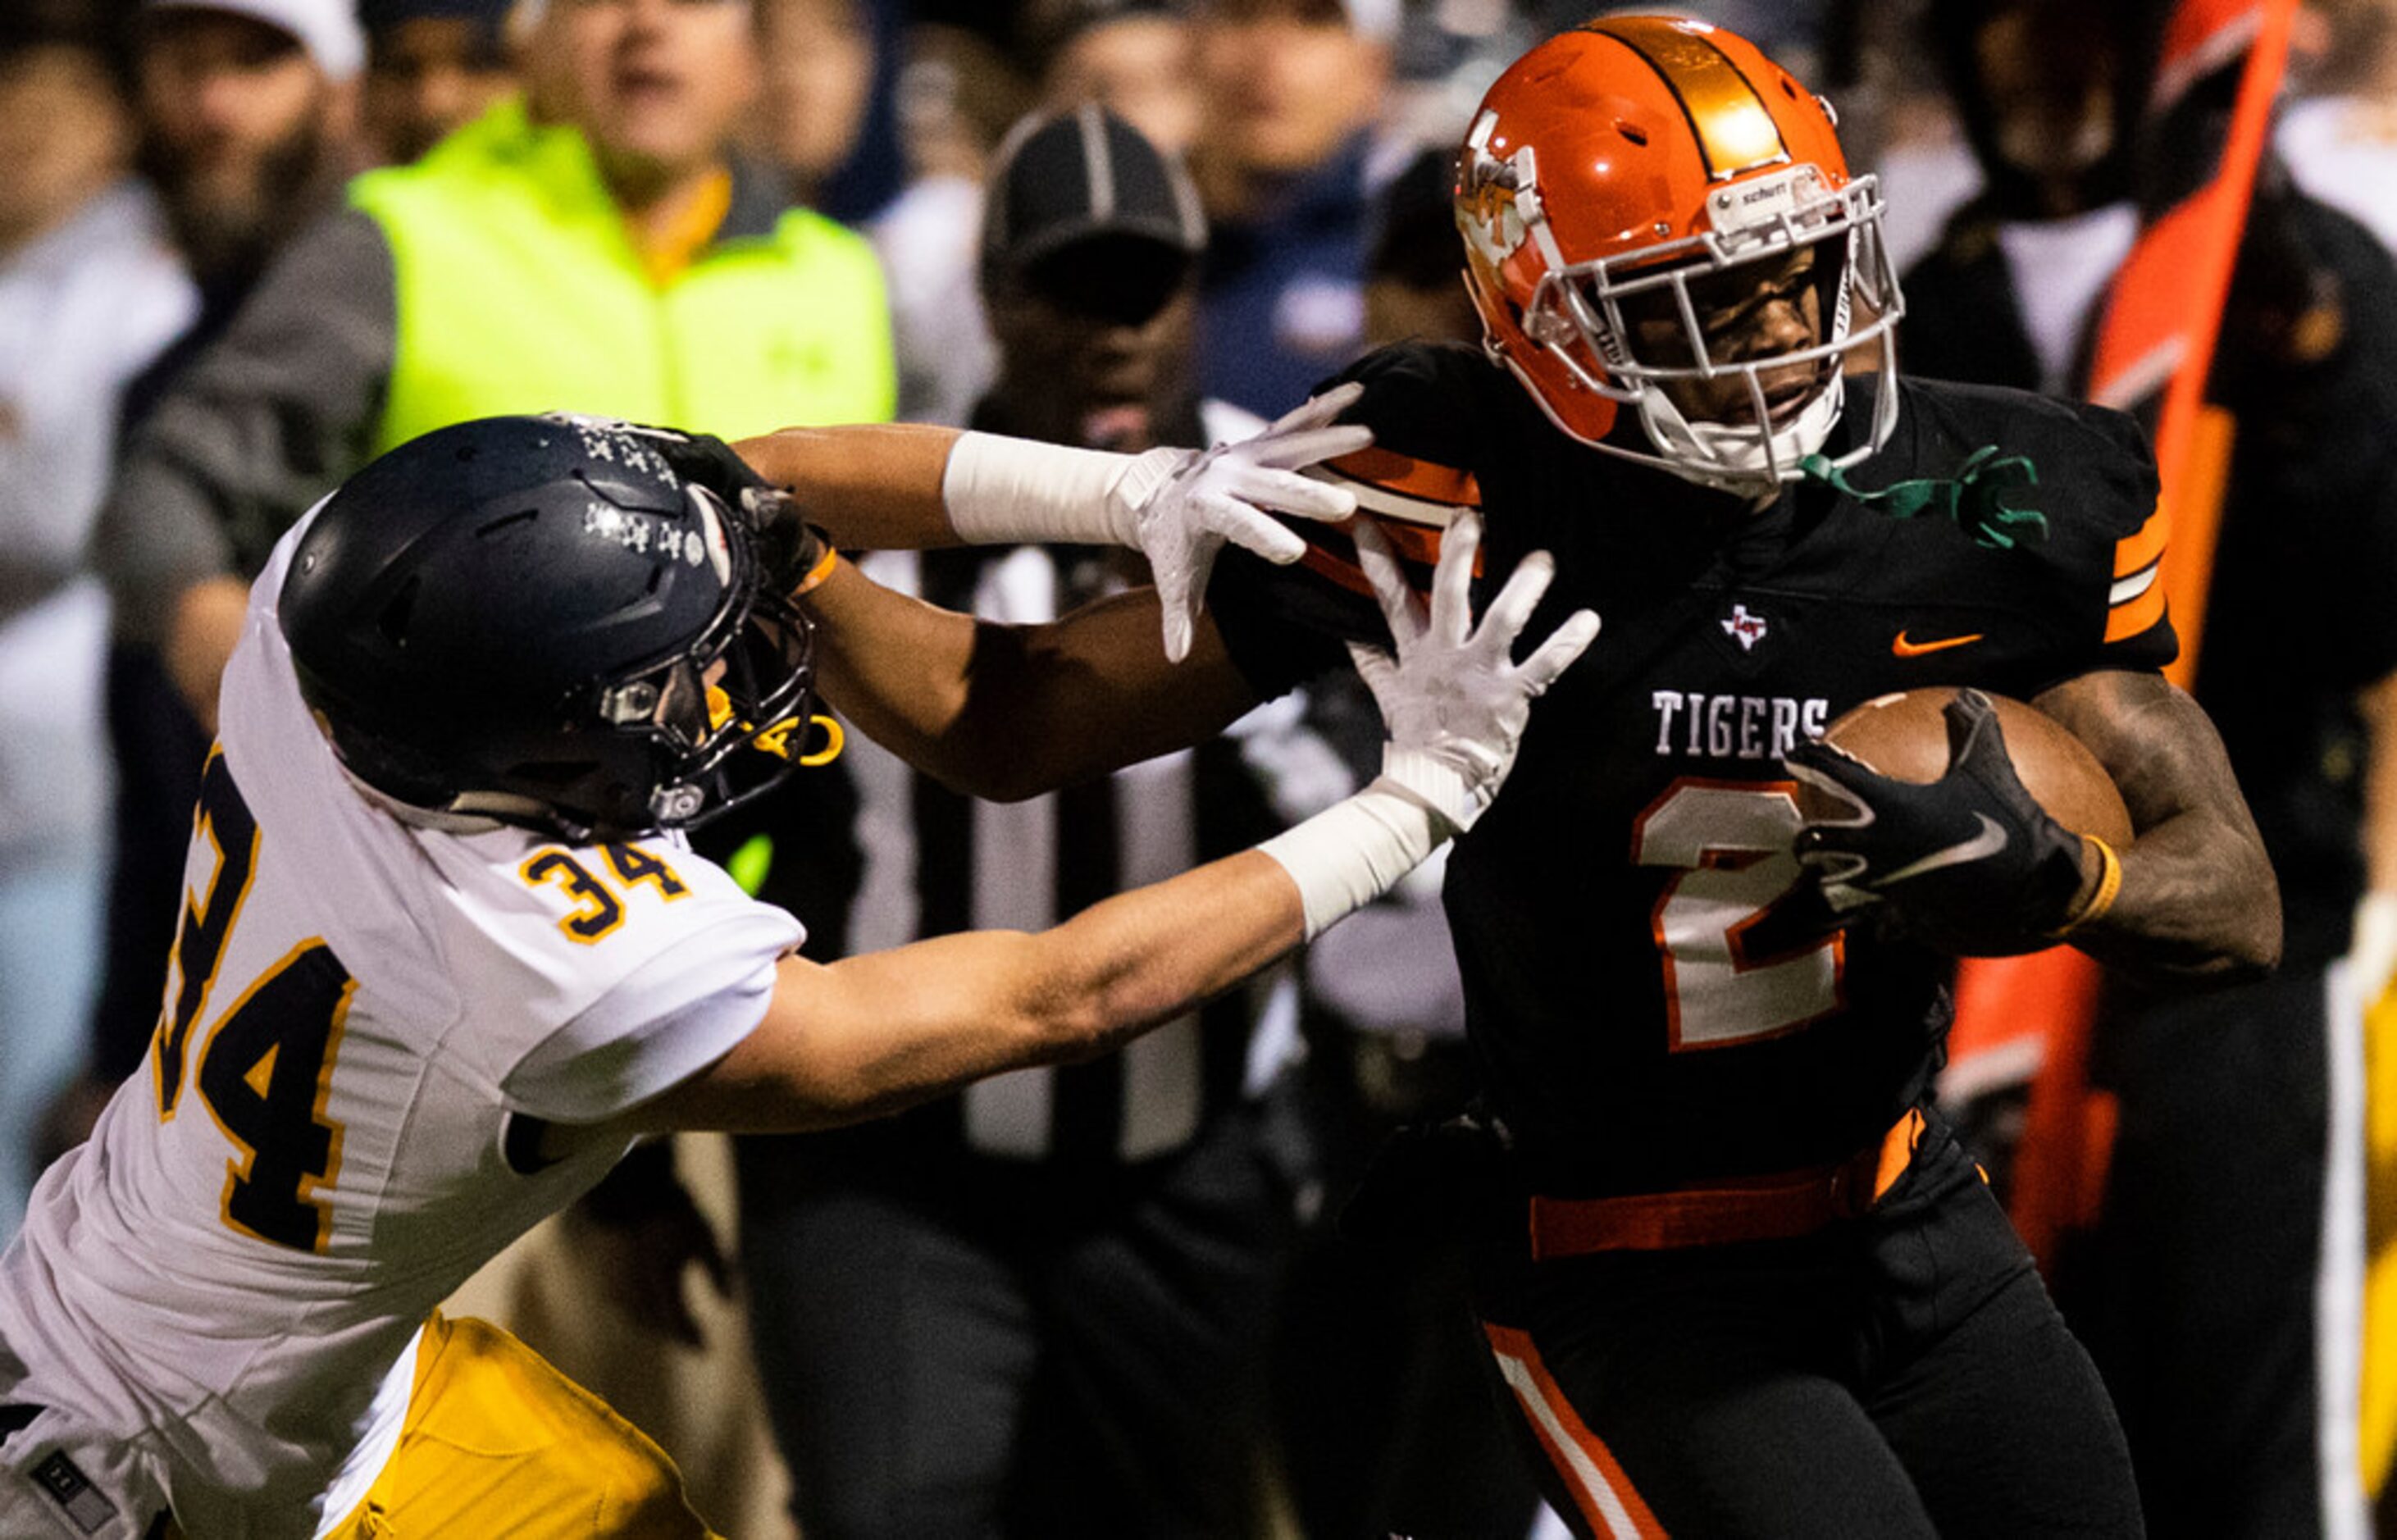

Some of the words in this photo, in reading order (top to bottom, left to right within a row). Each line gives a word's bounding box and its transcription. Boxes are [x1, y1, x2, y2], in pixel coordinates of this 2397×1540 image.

[1652, 690, 1828, 759] TIGERS
[517, 842, 694, 947] 34
[1629, 776, 1847, 1054] 2
